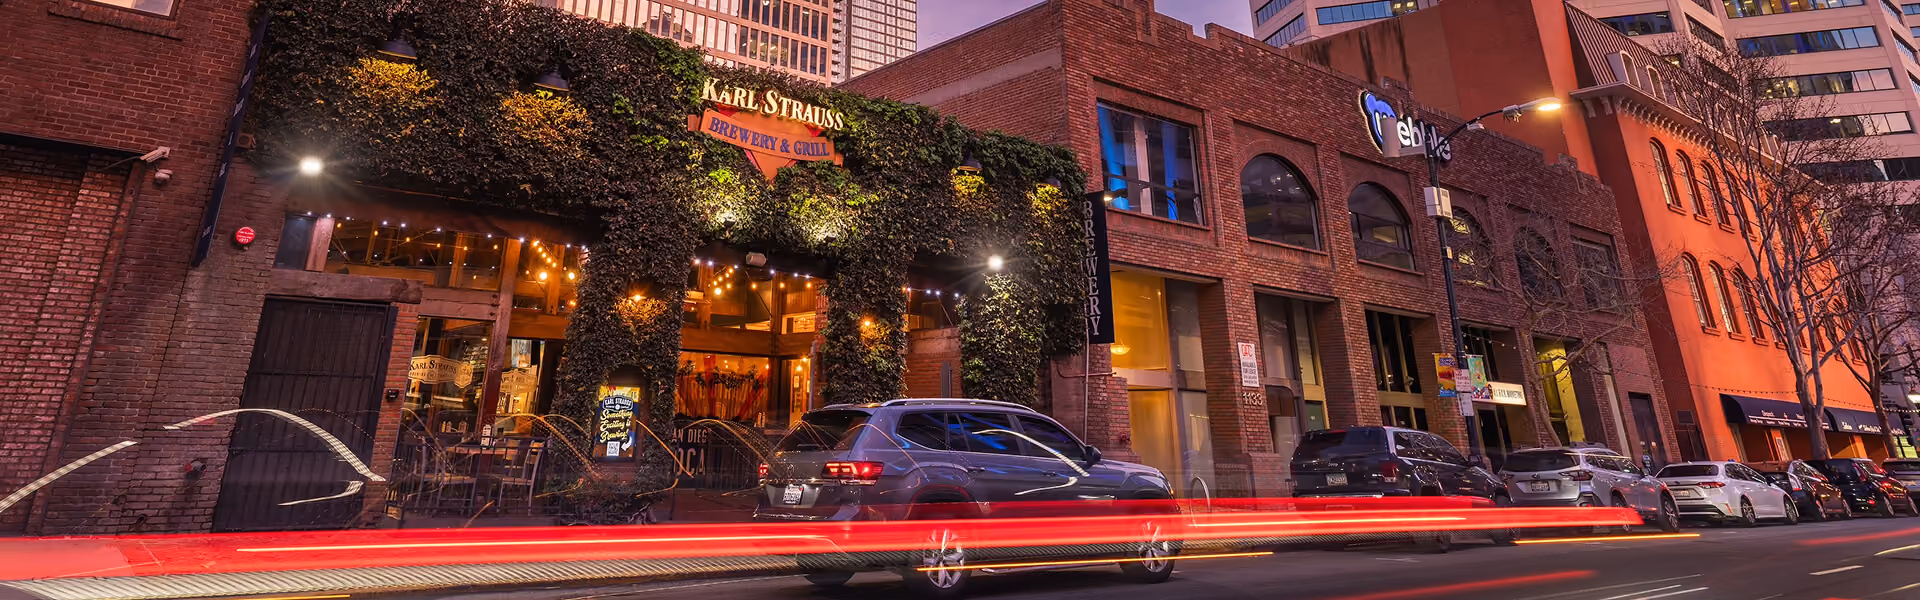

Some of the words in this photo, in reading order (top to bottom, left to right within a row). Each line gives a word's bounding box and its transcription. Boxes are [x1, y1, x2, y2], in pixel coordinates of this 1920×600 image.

[700, 77, 759, 110] KARL
[763, 89, 845, 131] STRAUSS
[708, 116, 779, 151] BREWERY
[780, 138, 790, 153] &
[794, 141, 830, 157] GRILL
[1084, 200, 1101, 336] BREWERY
[410, 361, 427, 371] KARL
[1243, 392, 1263, 406] 1133
[600, 409, 633, 420] Something
[600, 420, 625, 431] Exciting
[671, 428, 684, 442] AN
[687, 428, 708, 443] DIEG
[673, 448, 706, 477] OCA
